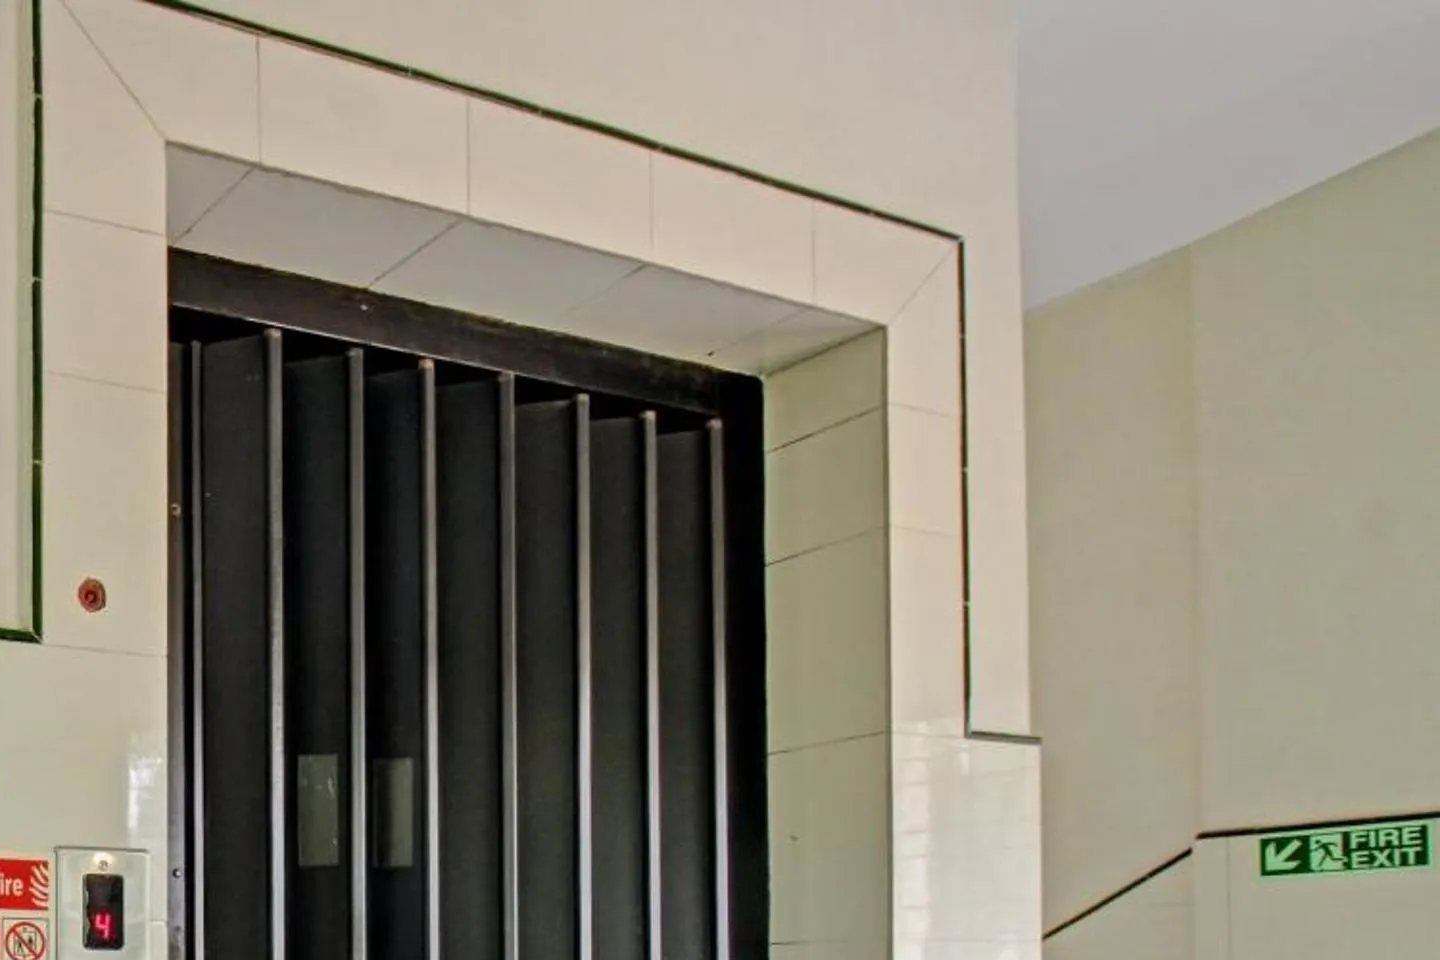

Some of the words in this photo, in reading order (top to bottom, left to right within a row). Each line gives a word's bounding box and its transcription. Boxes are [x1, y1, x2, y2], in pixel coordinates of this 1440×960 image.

[1349, 826, 1423, 849] FIRE
[1350, 846, 1424, 869] EXIT
[94, 912, 112, 940] 4
